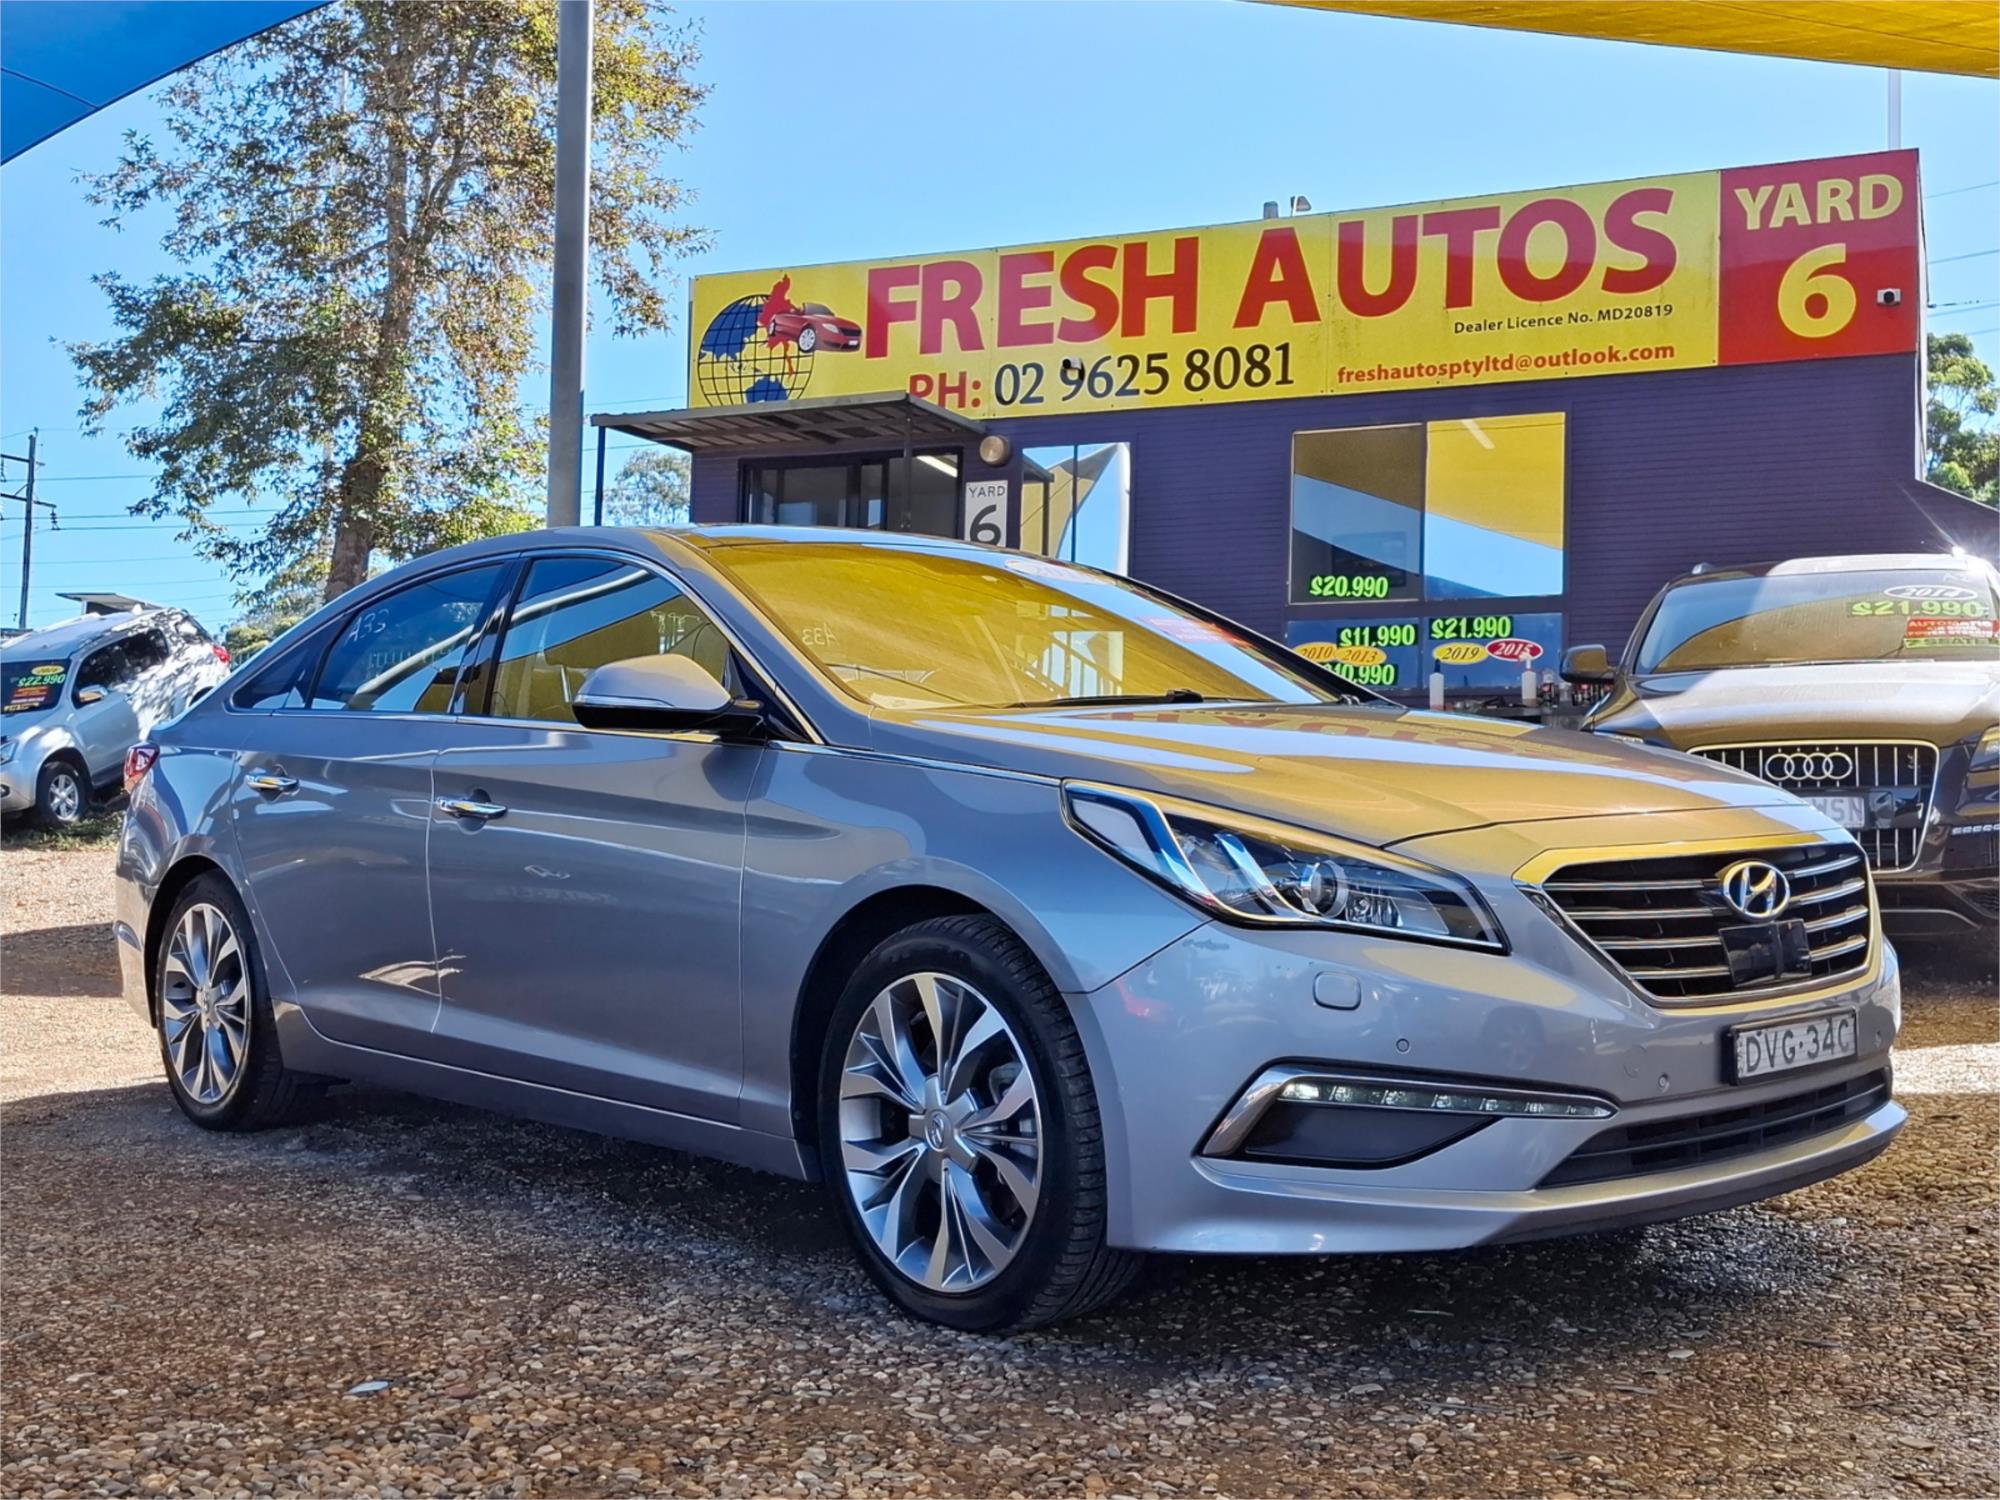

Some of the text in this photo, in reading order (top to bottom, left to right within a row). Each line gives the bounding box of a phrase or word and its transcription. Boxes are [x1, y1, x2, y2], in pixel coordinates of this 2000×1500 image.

[1734, 173, 1904, 230] YARD
[865, 188, 1679, 359] FRESH AUTOS
[1777, 243, 1857, 338] 6
[1454, 304, 1673, 334] Dealer Licence No. MD20819
[908, 342, 1294, 408] PH: 02 9625 8081
[1337, 344, 1675, 384] freshautosptyltd@outlook.com
[968, 485, 1006, 498] YARD
[969, 504, 1002, 545] 6
[1309, 575, 1389, 598] $20.990
[1339, 624, 1416, 647] $11.990
[1429, 615, 1512, 639] $21.990
[1342, 649, 1378, 663] 2013
[1442, 646, 1480, 660] 2019
[1494, 642, 1532, 656] 2015
